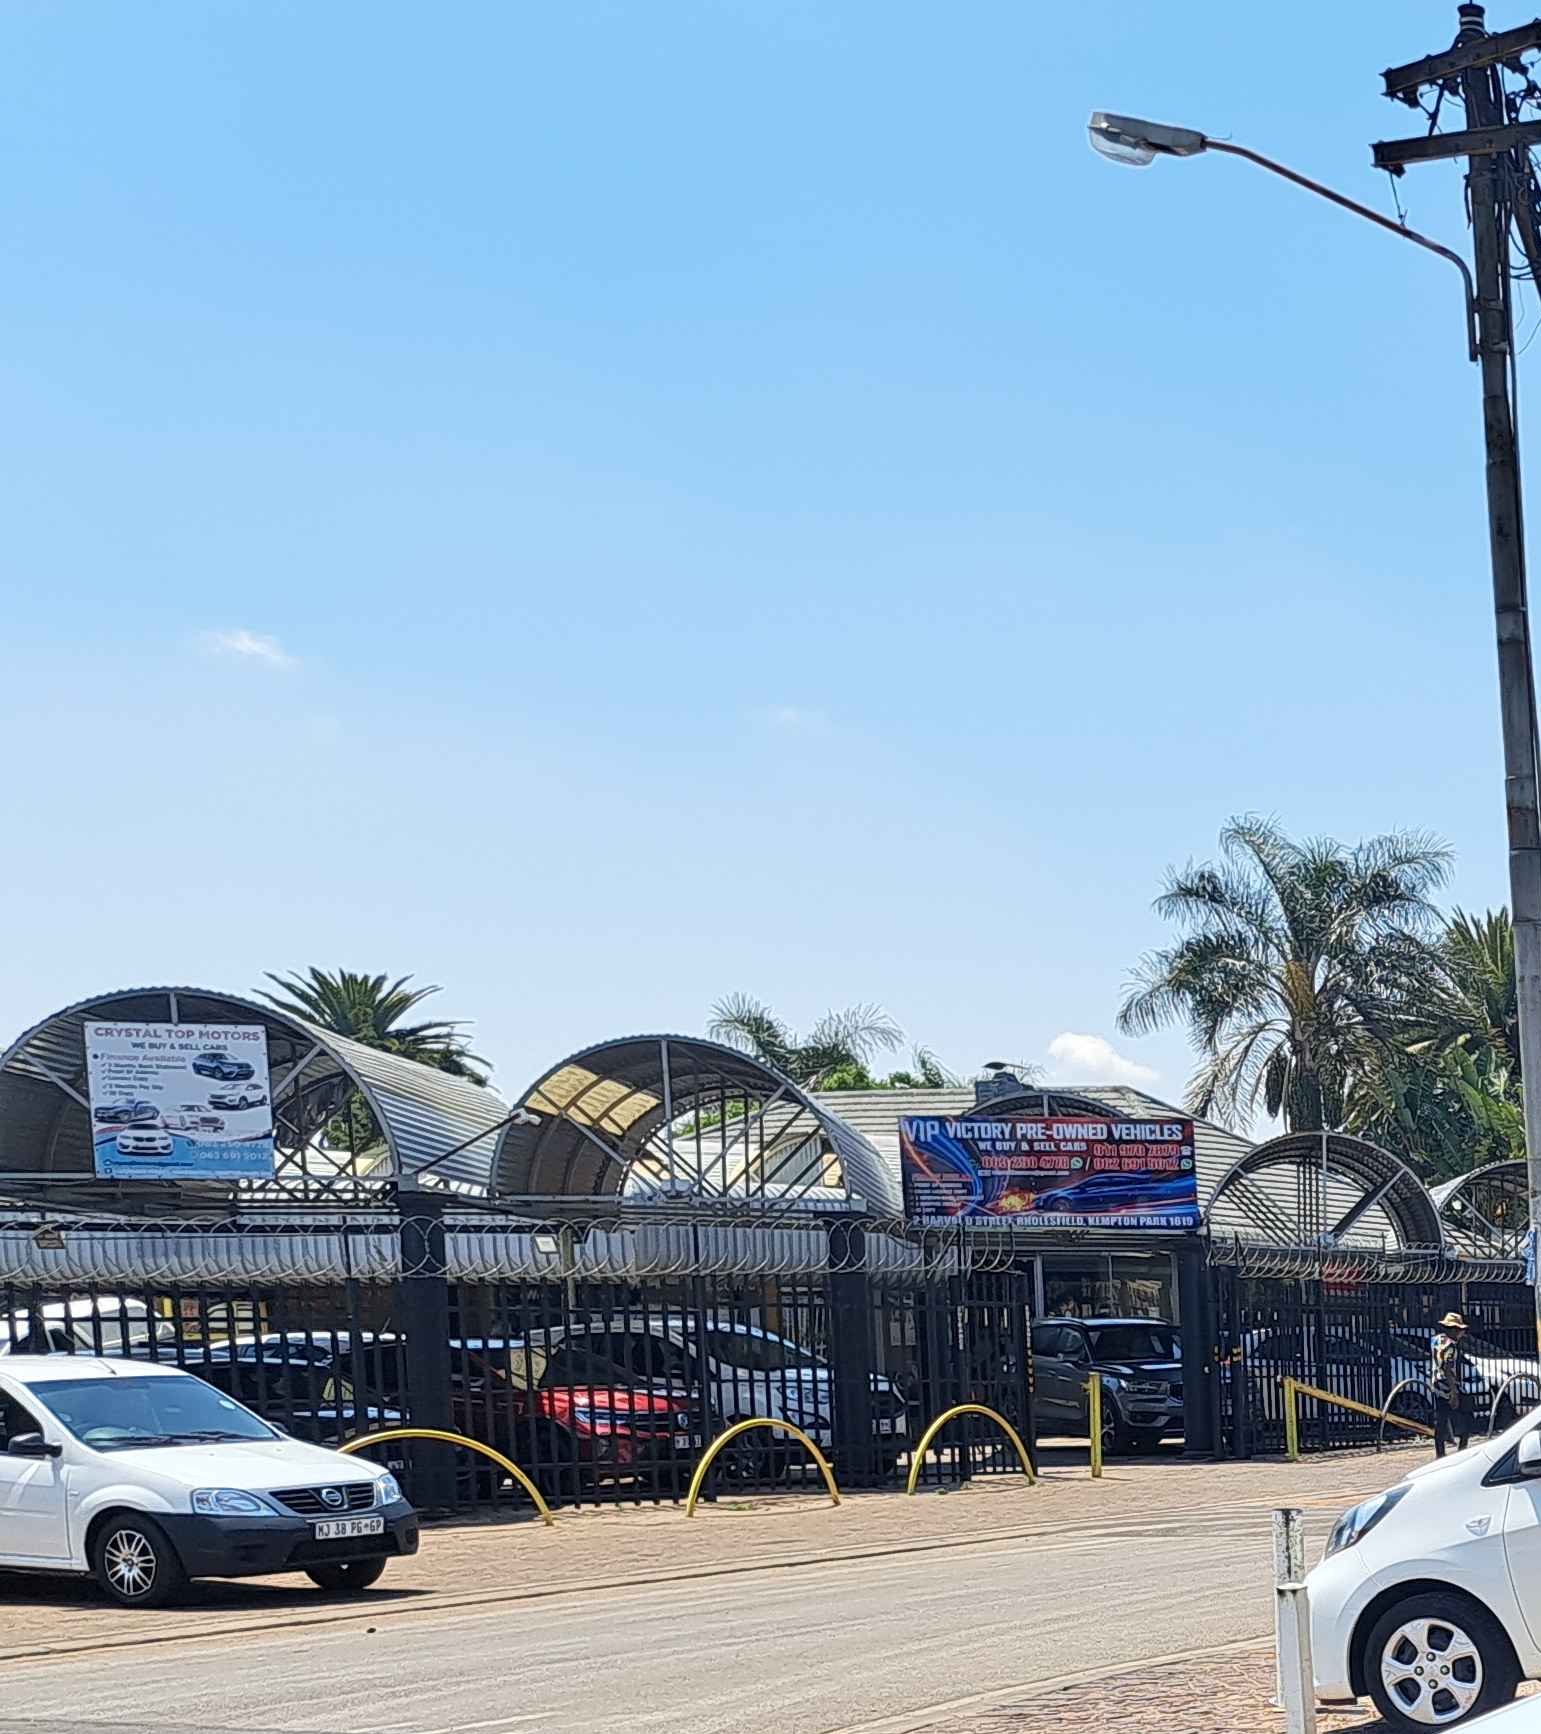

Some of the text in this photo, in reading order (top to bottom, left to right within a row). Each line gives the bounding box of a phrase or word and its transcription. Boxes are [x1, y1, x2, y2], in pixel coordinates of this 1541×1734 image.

[94, 1027, 261, 1041] CRYSTAL TOP MOTORS
[131, 1042, 146, 1050] WE
[178, 1043, 201, 1051] SELL
[903, 1120, 1183, 1142] VIP VICTORY PRE-OWNED VEHICLES
[978, 1141, 994, 1151] WE
[995, 1141, 1016, 1151] BUY
[1033, 1142, 1056, 1151] SELL
[1060, 1142, 1088, 1151] CARS
